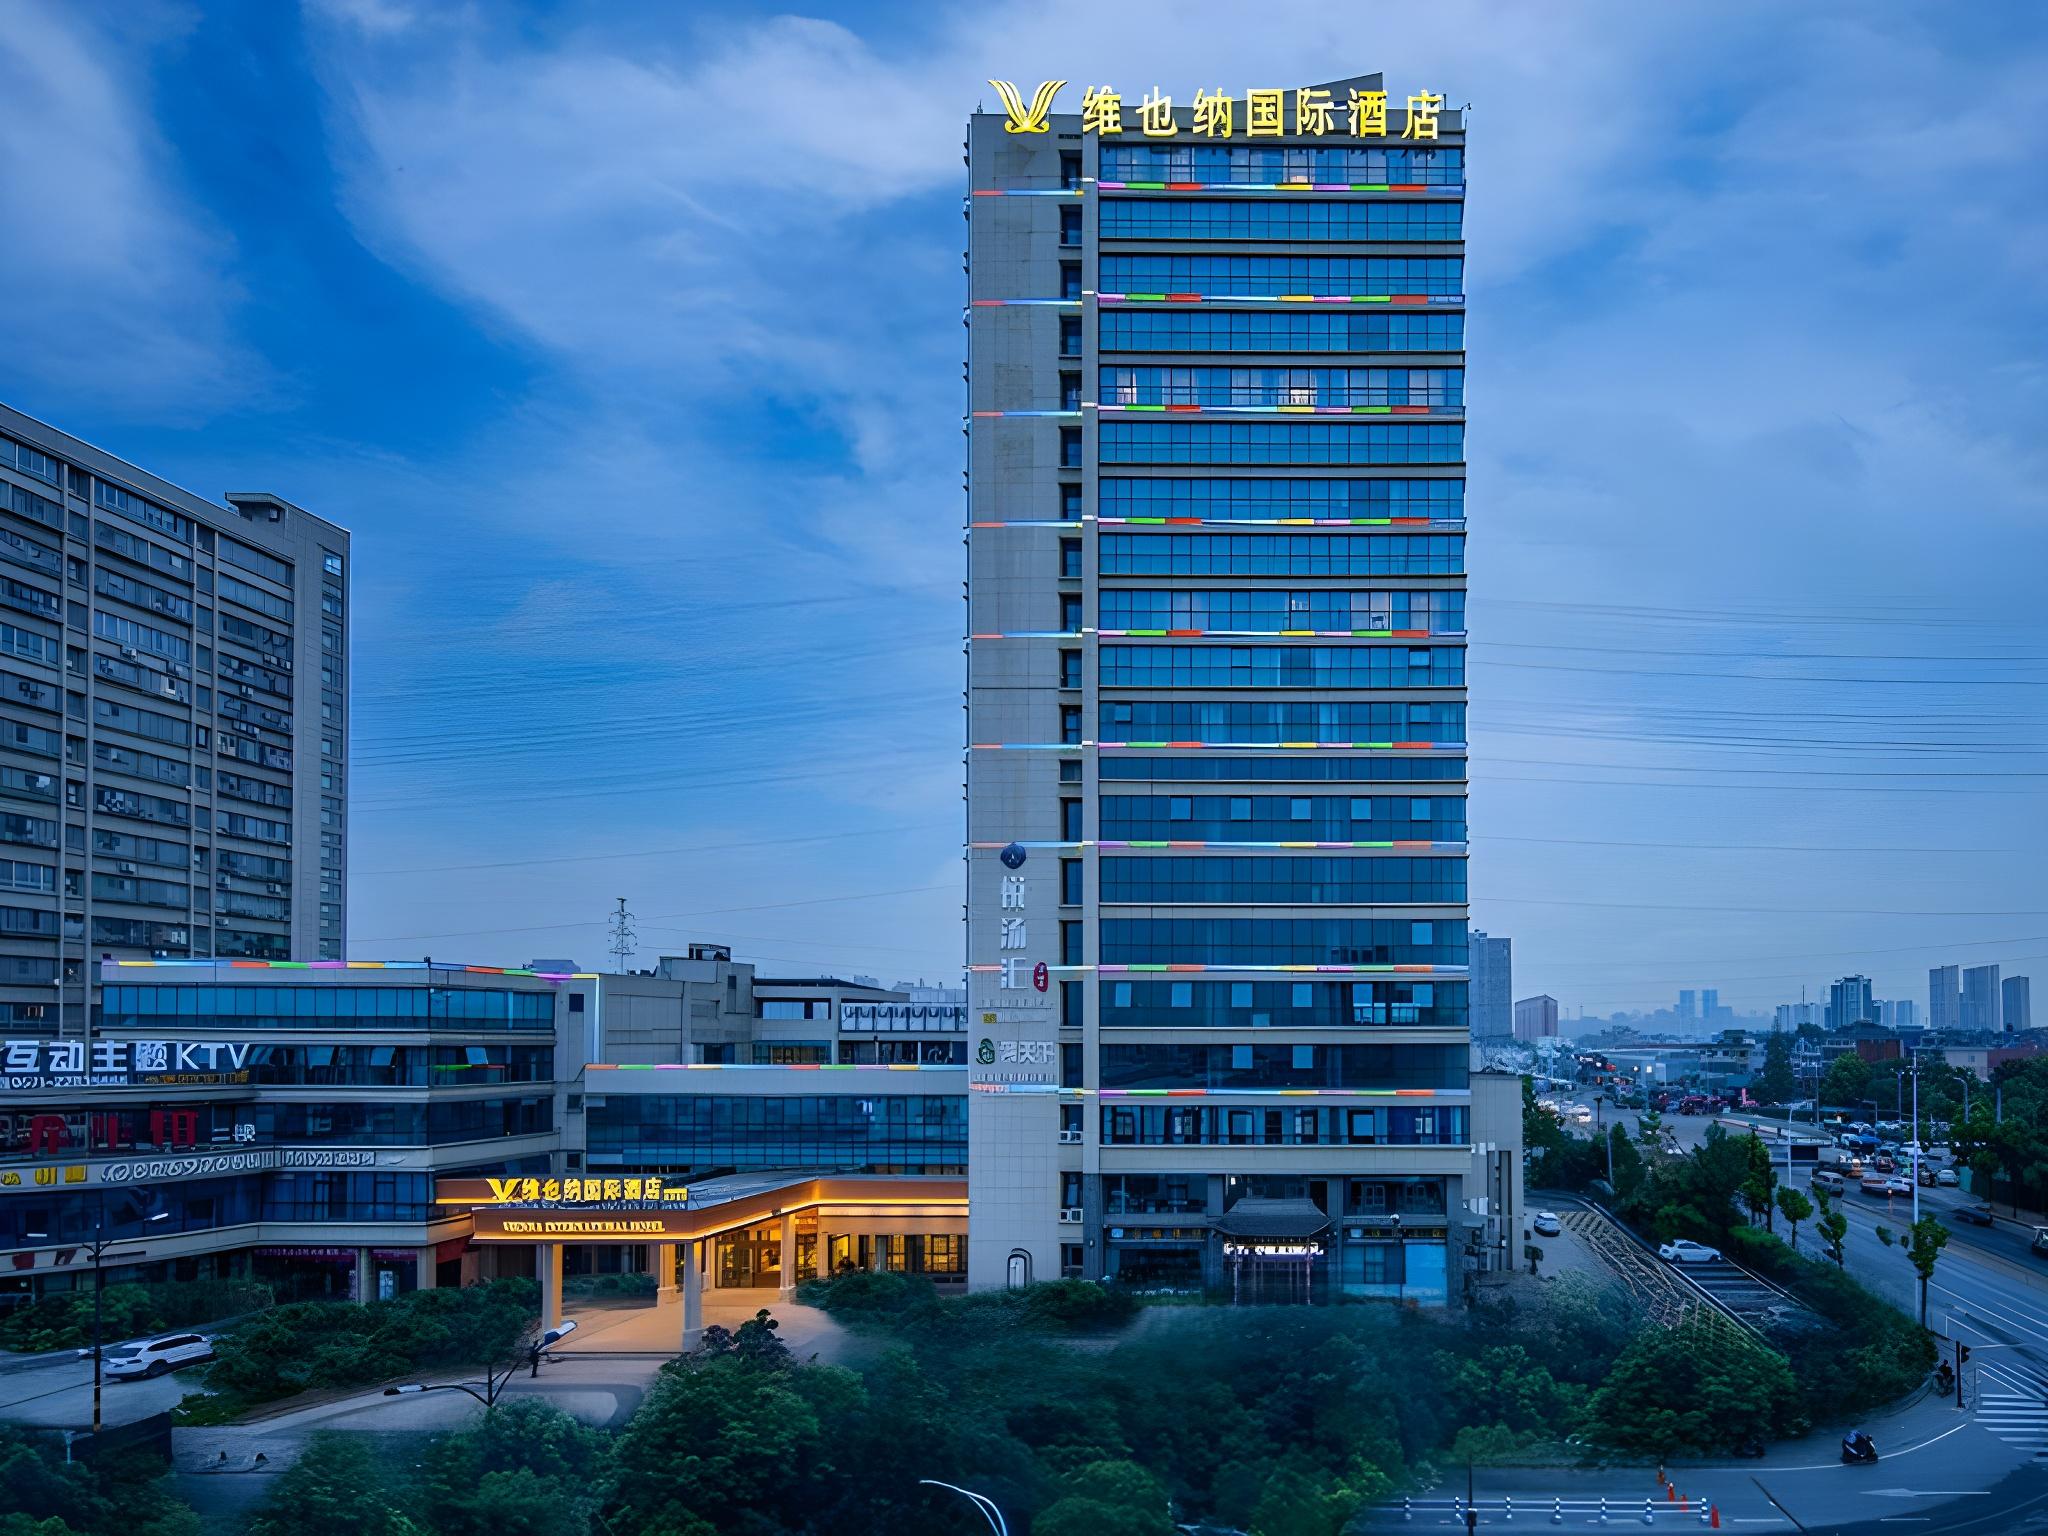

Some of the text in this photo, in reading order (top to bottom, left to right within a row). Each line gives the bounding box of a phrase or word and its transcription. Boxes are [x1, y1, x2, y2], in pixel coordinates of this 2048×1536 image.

[1082, 85, 1443, 140] 维也纳国际酒店
